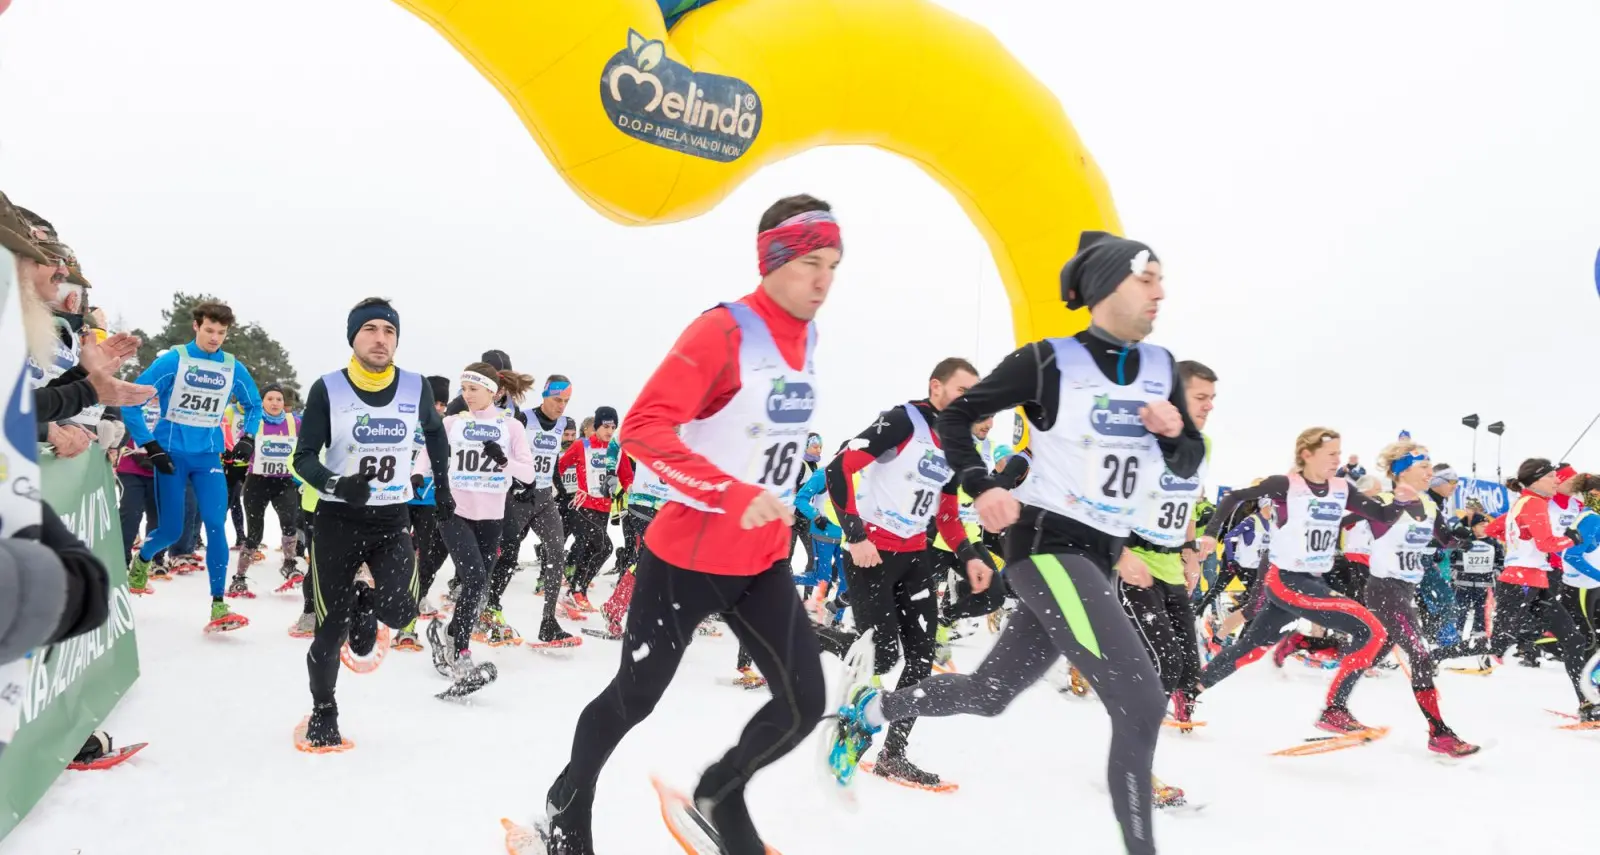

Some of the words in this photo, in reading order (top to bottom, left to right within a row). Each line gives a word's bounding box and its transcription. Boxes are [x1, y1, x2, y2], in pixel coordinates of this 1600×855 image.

[655, 127, 688, 146] MELA
[690, 137, 710, 150] VAL
[710, 140, 721, 151] DI
[722, 142, 741, 157] NON
[186, 372, 224, 386] Melinda
[179, 393, 220, 412] 2541
[355, 423, 405, 437] Melinda
[464, 427, 500, 438] Melinda
[359, 455, 396, 483] 68
[534, 455, 551, 474] 35
[757, 441, 798, 486] 16
[1102, 454, 1139, 499] 26
[1158, 502, 1188, 529] 39
